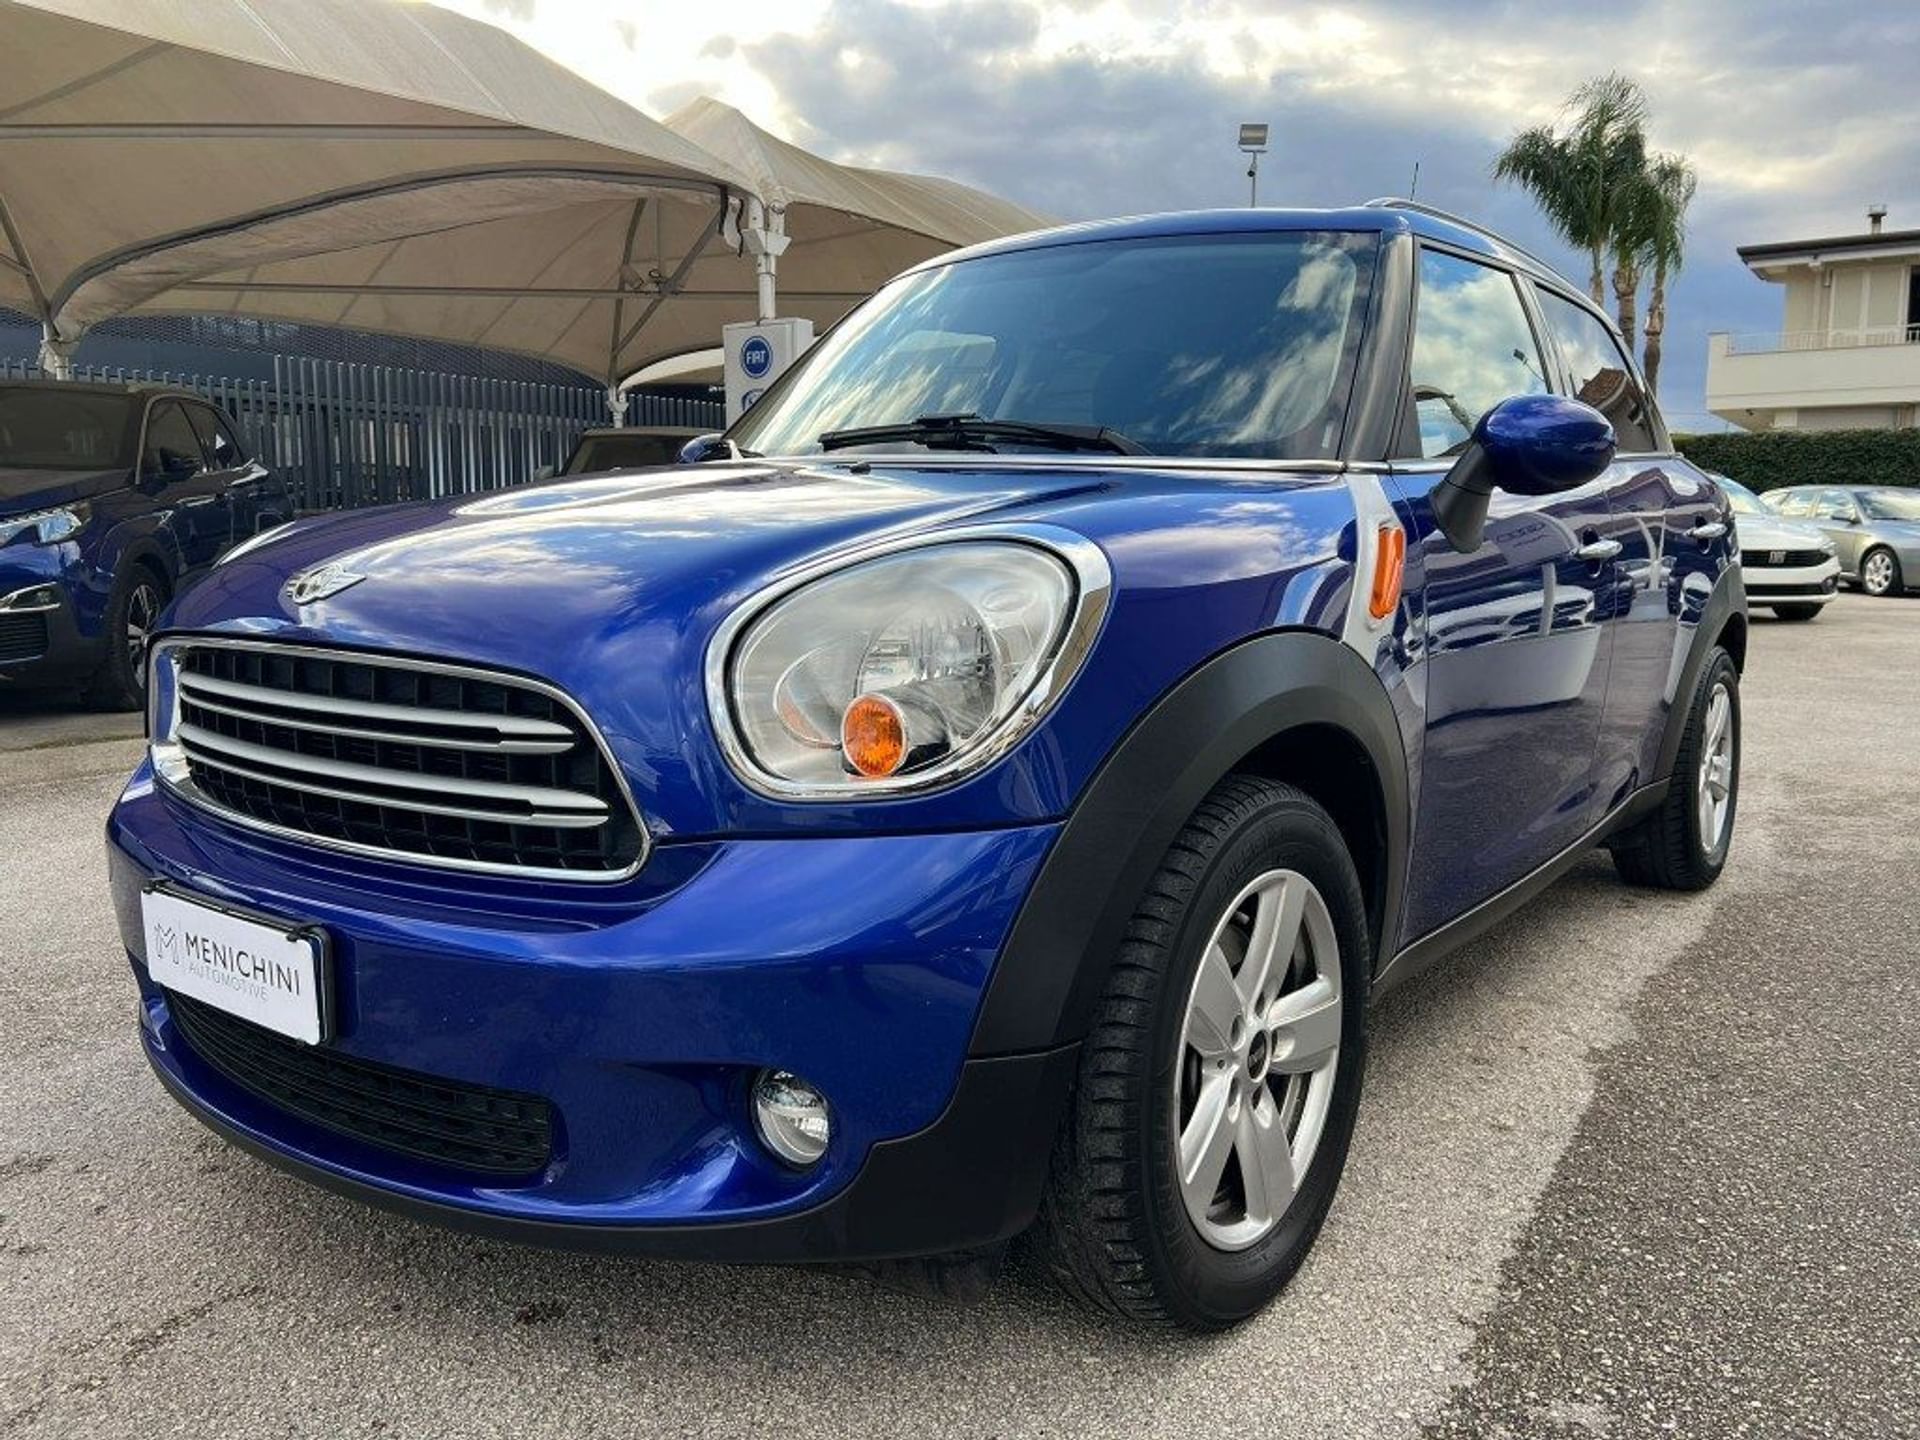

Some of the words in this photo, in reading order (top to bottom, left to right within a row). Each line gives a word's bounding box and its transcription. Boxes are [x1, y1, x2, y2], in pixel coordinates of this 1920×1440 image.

[746, 350, 766, 365] FIAT
[185, 931, 300, 996] MENICHINI
[189, 962, 268, 1000] AUTOMOTIVE
